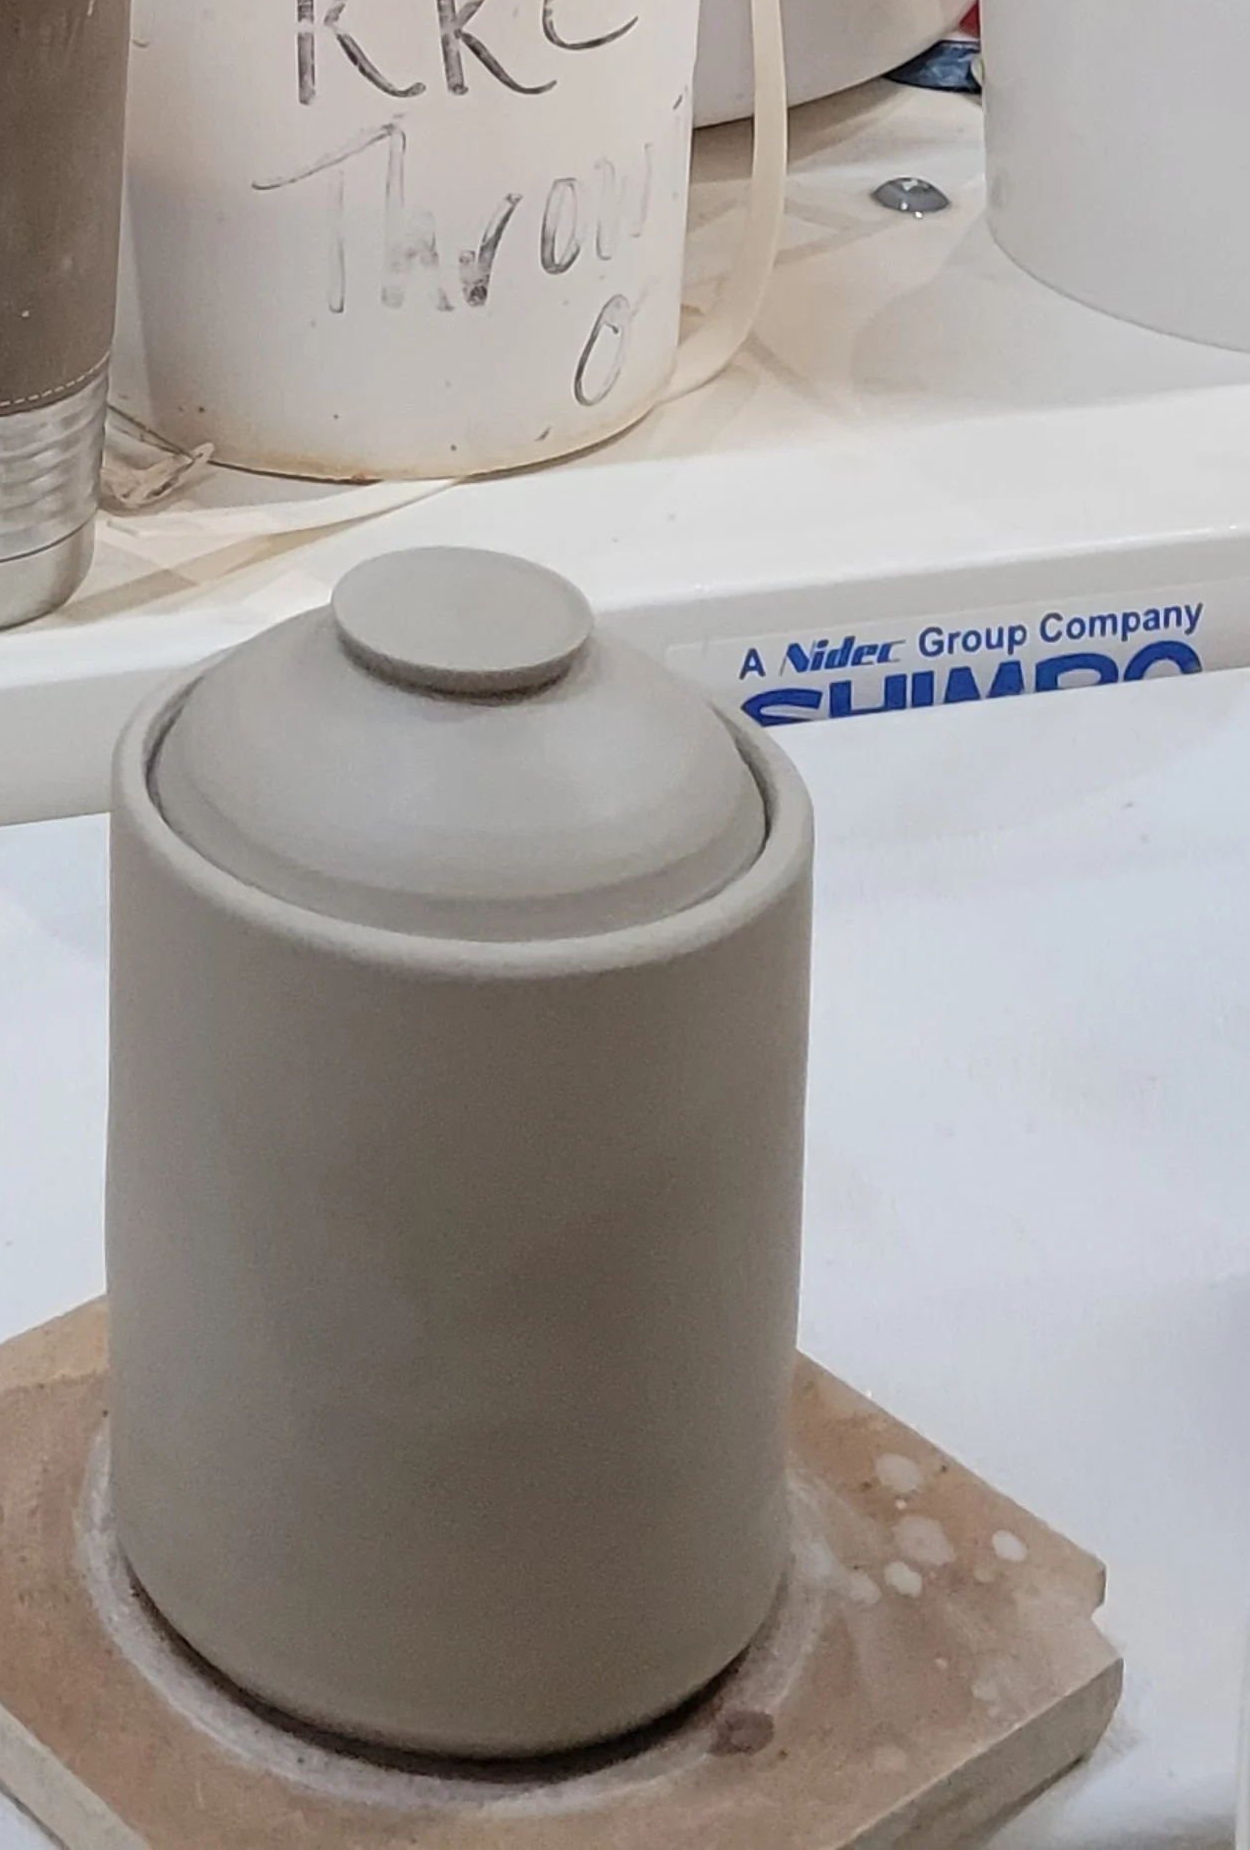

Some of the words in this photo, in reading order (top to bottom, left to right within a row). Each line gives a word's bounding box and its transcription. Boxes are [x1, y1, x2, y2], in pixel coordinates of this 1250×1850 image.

[739, 647, 767, 681] A
[778, 635, 906, 677] Nidec
[918, 625, 1027, 658] Group
[1039, 602, 1204, 643] Company
